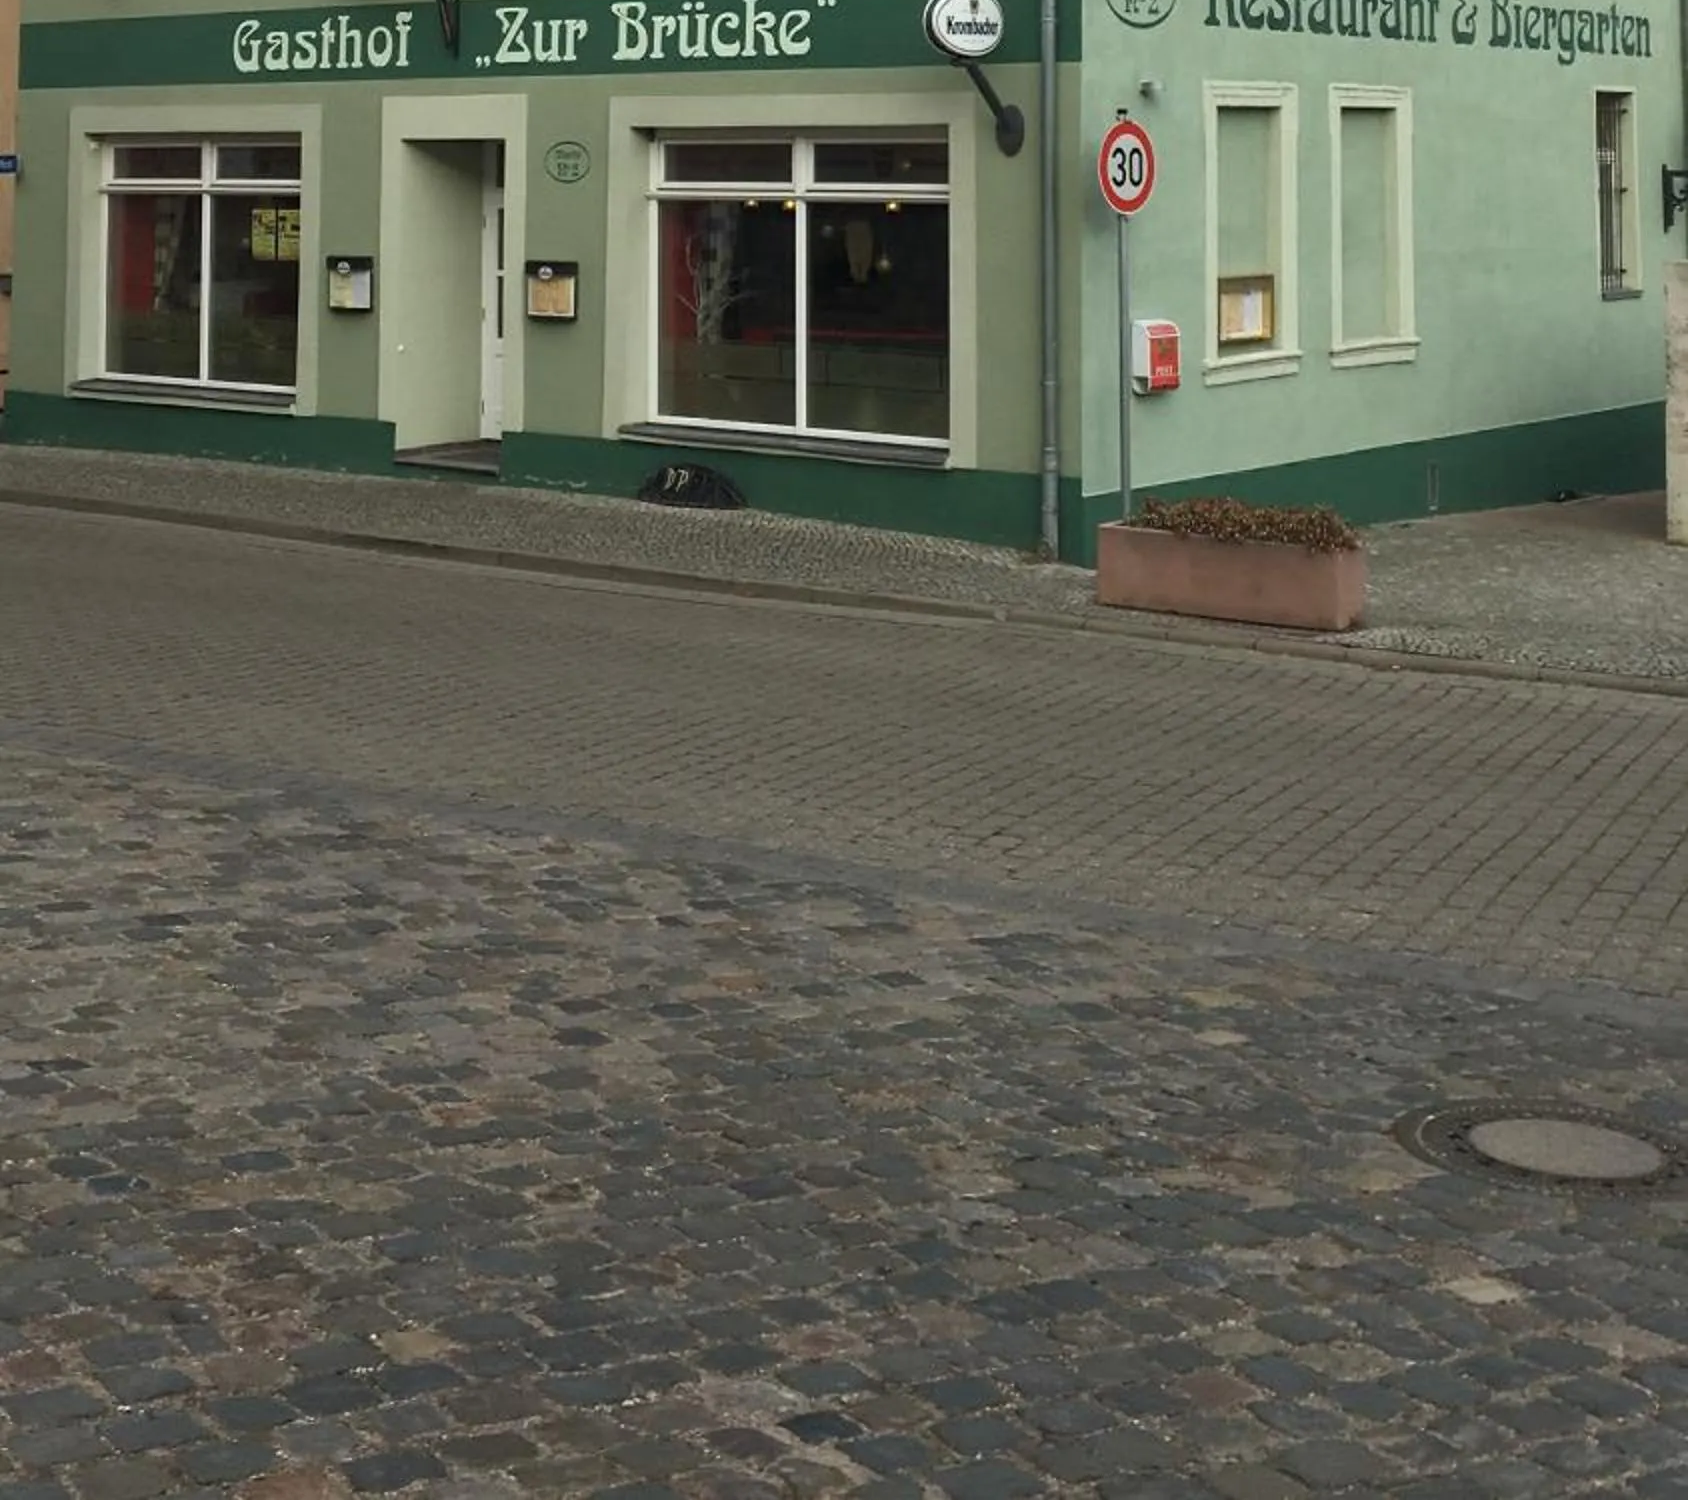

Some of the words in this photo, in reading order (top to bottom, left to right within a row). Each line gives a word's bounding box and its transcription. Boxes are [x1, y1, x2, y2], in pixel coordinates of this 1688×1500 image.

[233, 11, 413, 73] Gasthof
[946, 15, 998, 36] Krombacher
[1111, 147, 1144, 188] 30
